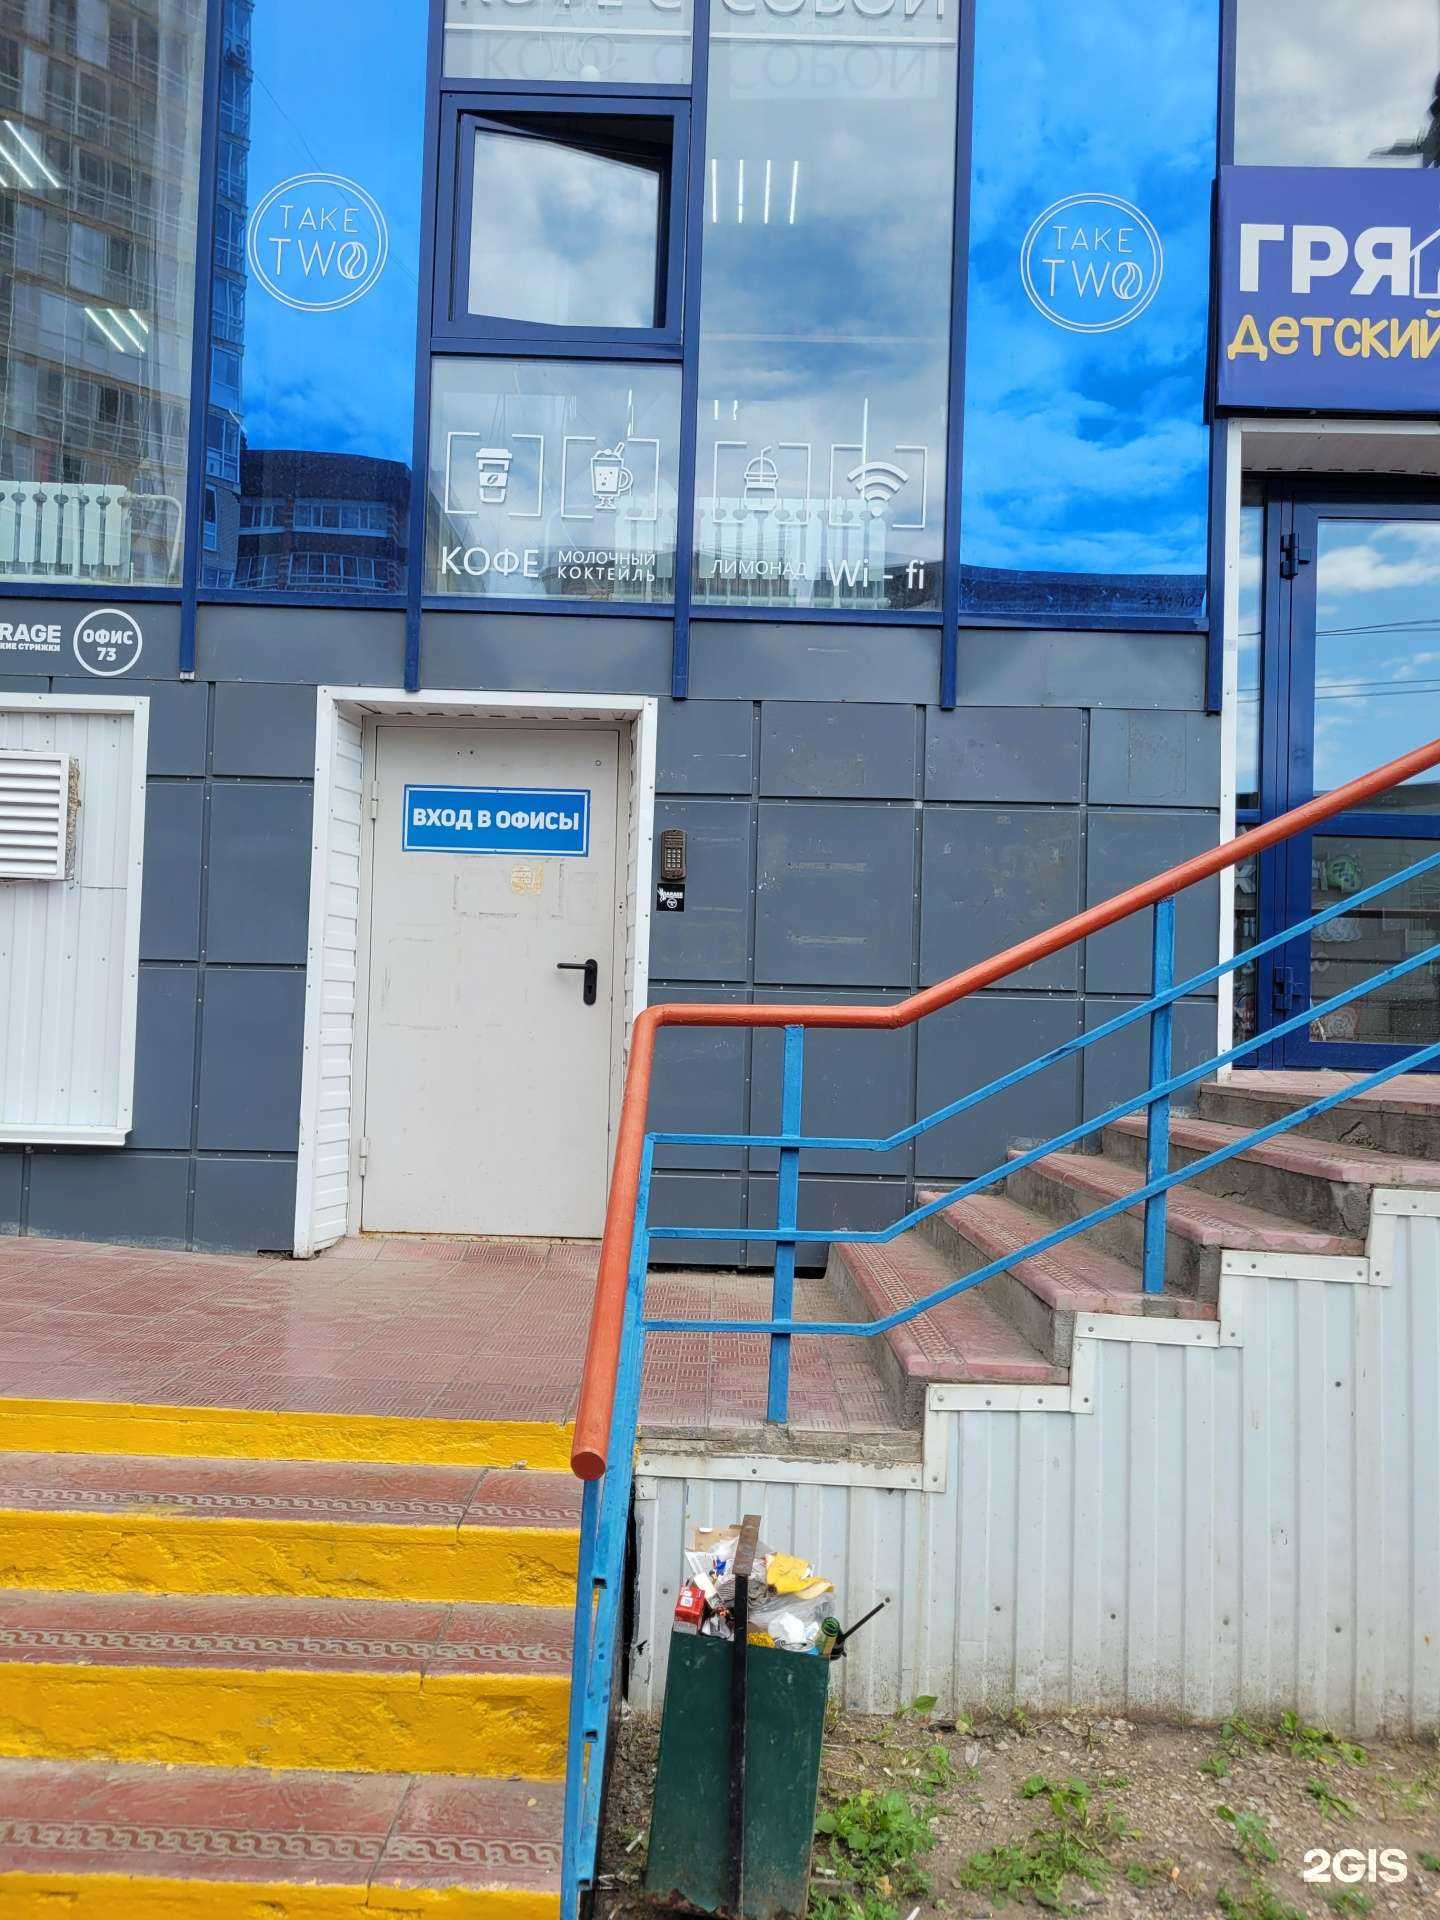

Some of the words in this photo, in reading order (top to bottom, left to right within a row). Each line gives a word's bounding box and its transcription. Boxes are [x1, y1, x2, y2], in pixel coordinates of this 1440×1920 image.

[280, 205, 359, 233] TAKE
[1052, 226, 1134, 254] TAKE
[268, 236, 368, 280] TWO
[1042, 259, 1143, 300] TWO
[441, 546, 540, 578] КОФЕ
[558, 550, 656, 566] МОЛОЧНЫЙ
[710, 559, 808, 576] ЛИМОНАД
[558, 564, 656, 582] КОКТЕЙЛЬ
[82, 629, 134, 645] ОФИС
[96, 646, 117, 661] 73
[413, 807, 473, 831] ВХОД
[477, 809, 492, 828] В
[495, 810, 580, 831] ОФИСЫ
